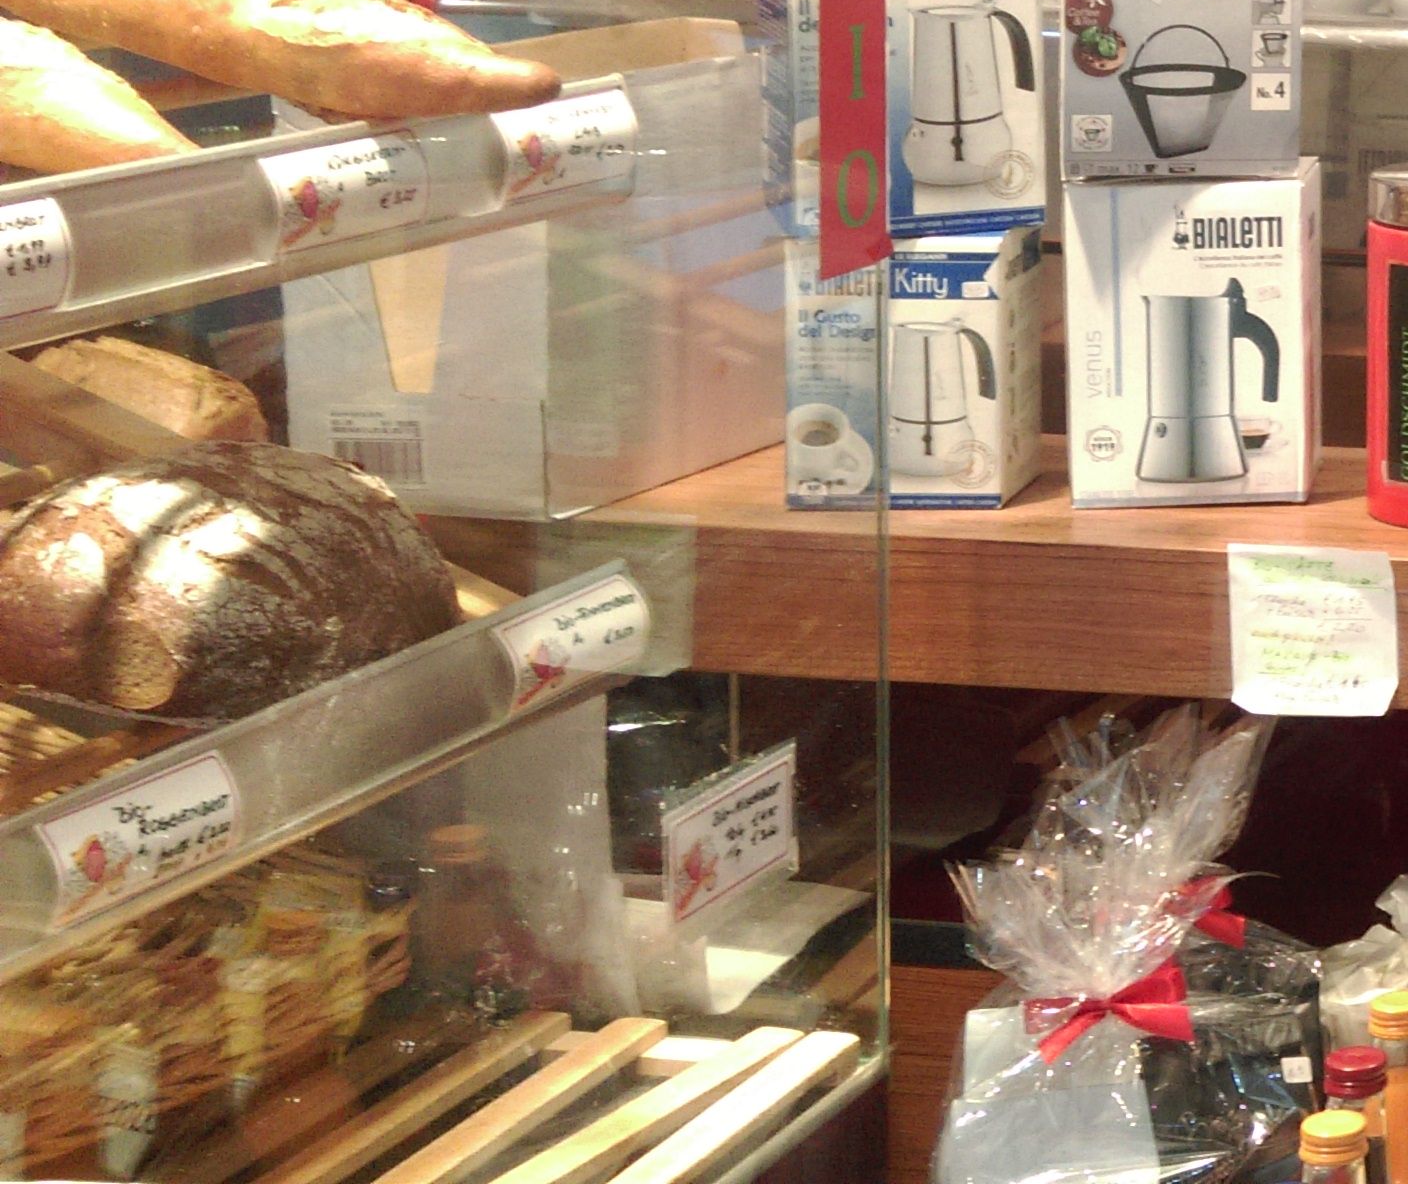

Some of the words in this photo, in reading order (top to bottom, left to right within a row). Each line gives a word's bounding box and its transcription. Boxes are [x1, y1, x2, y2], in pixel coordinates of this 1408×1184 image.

[1256, 87, 1273, 98] No.
[1274, 81, 1287, 99] 4
[1192, 216, 1283, 250] BIALETTI
[894, 267, 950, 297] Kitty
[814, 309, 862, 325] Gusto
[798, 325, 823, 339] del
[1086, 330, 1103, 399] venus
